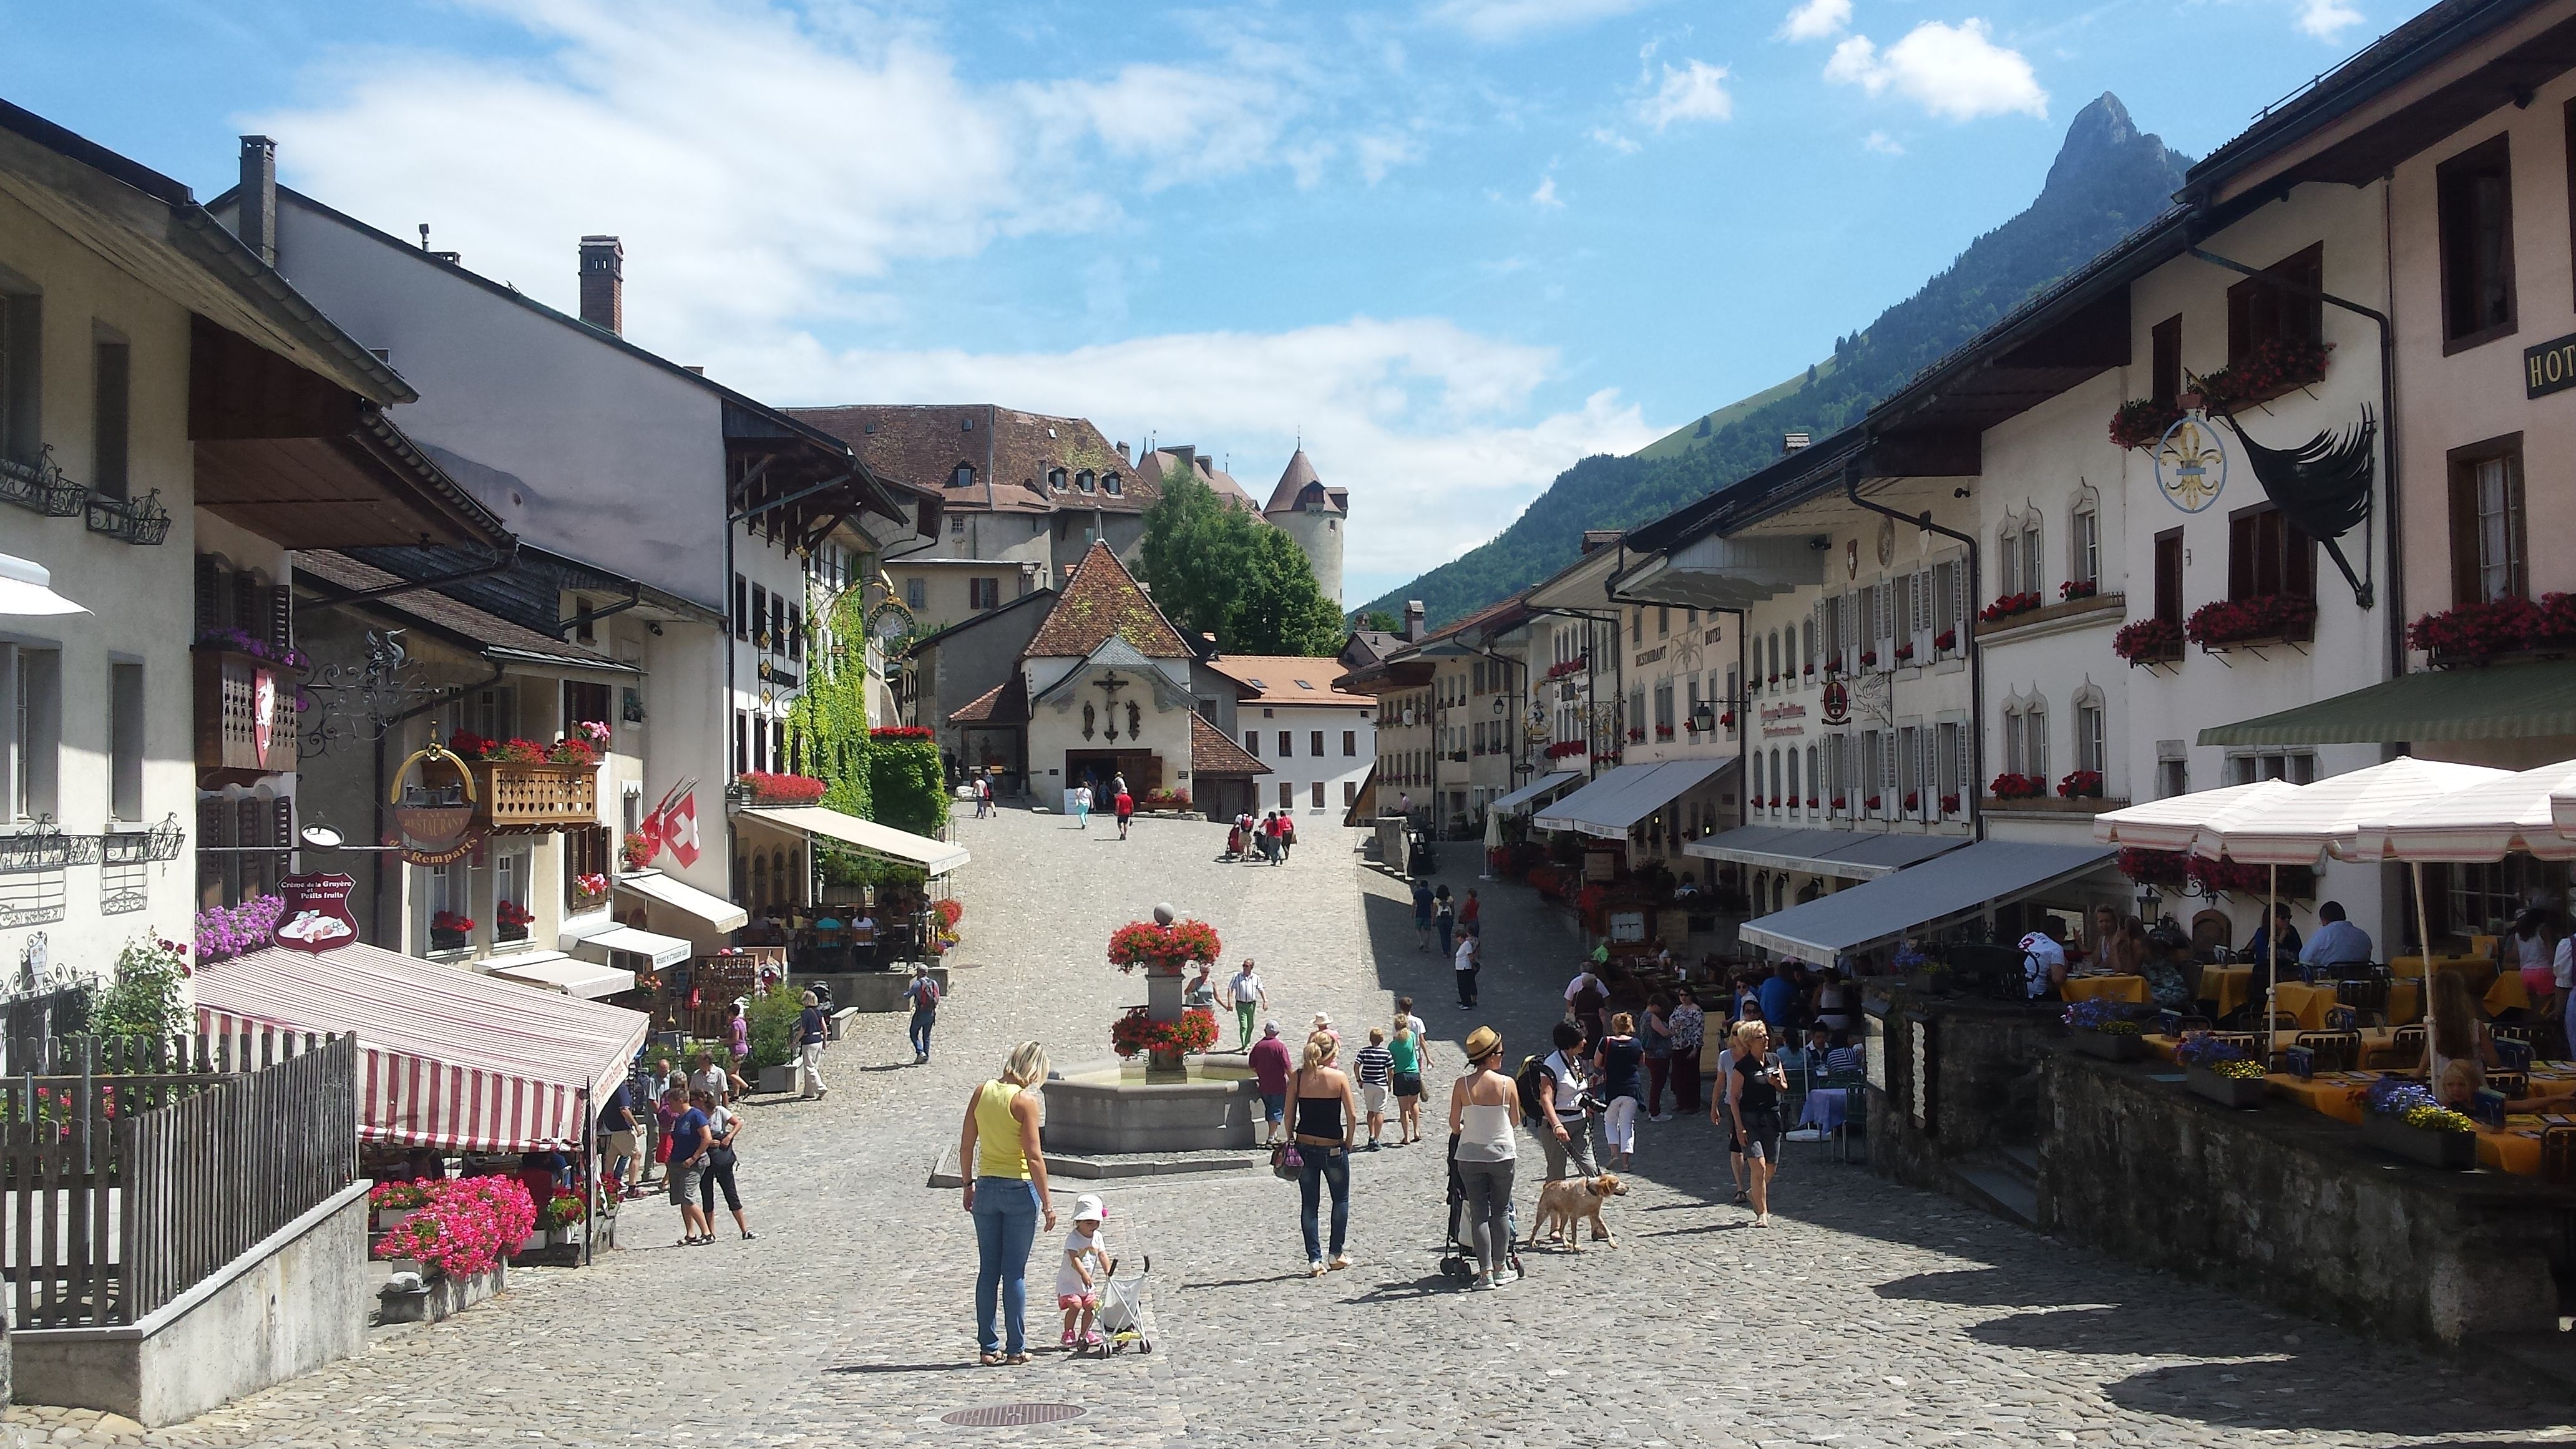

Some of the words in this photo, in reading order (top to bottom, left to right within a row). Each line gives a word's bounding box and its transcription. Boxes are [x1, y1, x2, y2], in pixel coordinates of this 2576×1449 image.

[2529, 344, 2576, 388] HOT
[1636, 645, 1667, 668] RESTAURANT
[404, 818, 464, 836] RESTAURANT
[411, 837, 478, 864] Remparts
[322, 880, 352, 889] Gruyère
